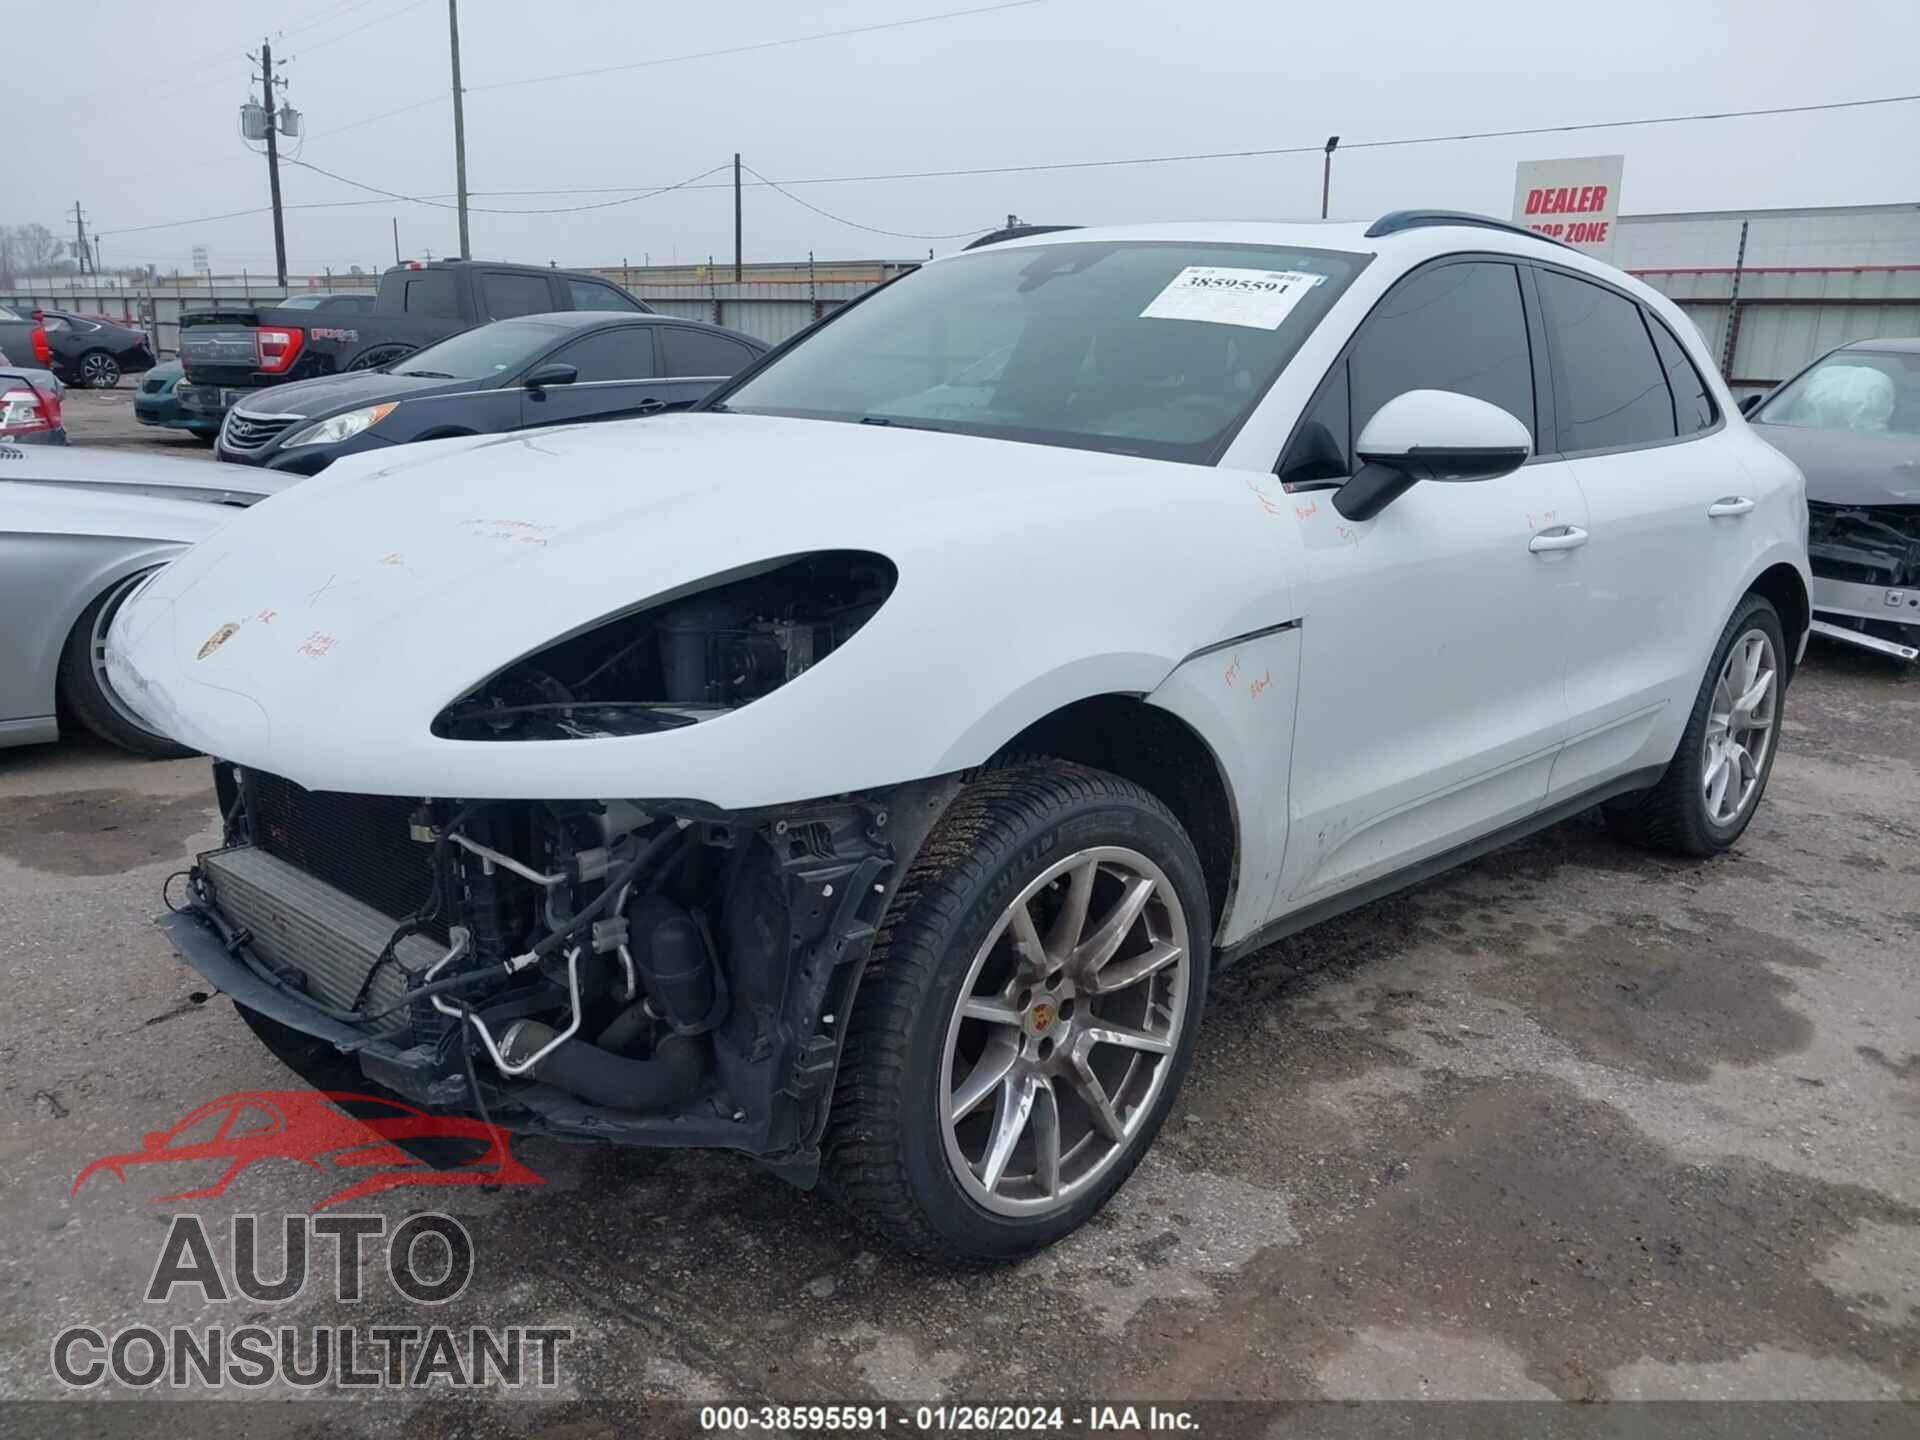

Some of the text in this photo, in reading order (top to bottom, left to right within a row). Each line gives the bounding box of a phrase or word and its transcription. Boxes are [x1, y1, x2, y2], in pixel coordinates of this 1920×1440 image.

[1525, 186, 1608, 215] DEALER
[1564, 222, 1609, 243] ZONE
[1183, 276, 1290, 295] 38595591
[311, 328, 356, 341] FX4
